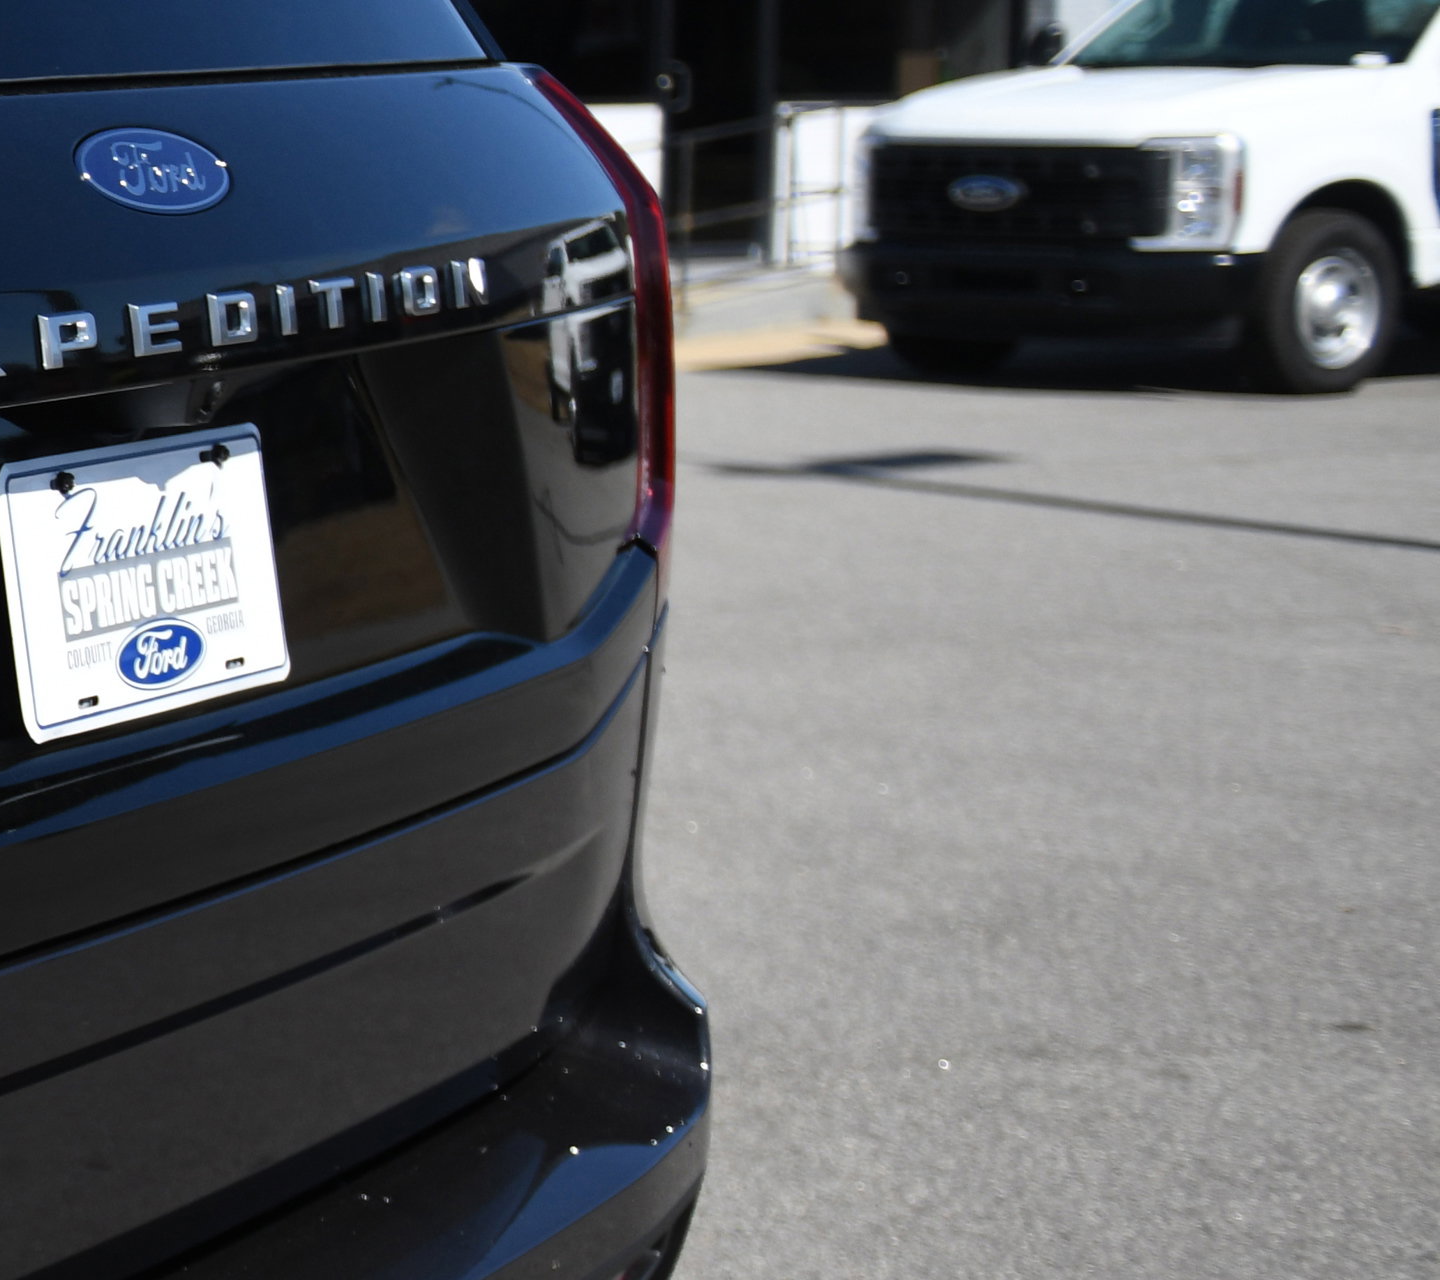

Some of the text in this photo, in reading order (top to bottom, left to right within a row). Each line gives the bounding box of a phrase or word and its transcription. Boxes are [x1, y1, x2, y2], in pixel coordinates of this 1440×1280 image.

[110, 141, 206, 196] Ford
[55, 483, 229, 578] Franklin's
[61, 545, 239, 636] SPRING CREEK
[66, 609, 245, 669] COLQUITT GEORGIA
[133, 628, 189, 680] Ford
